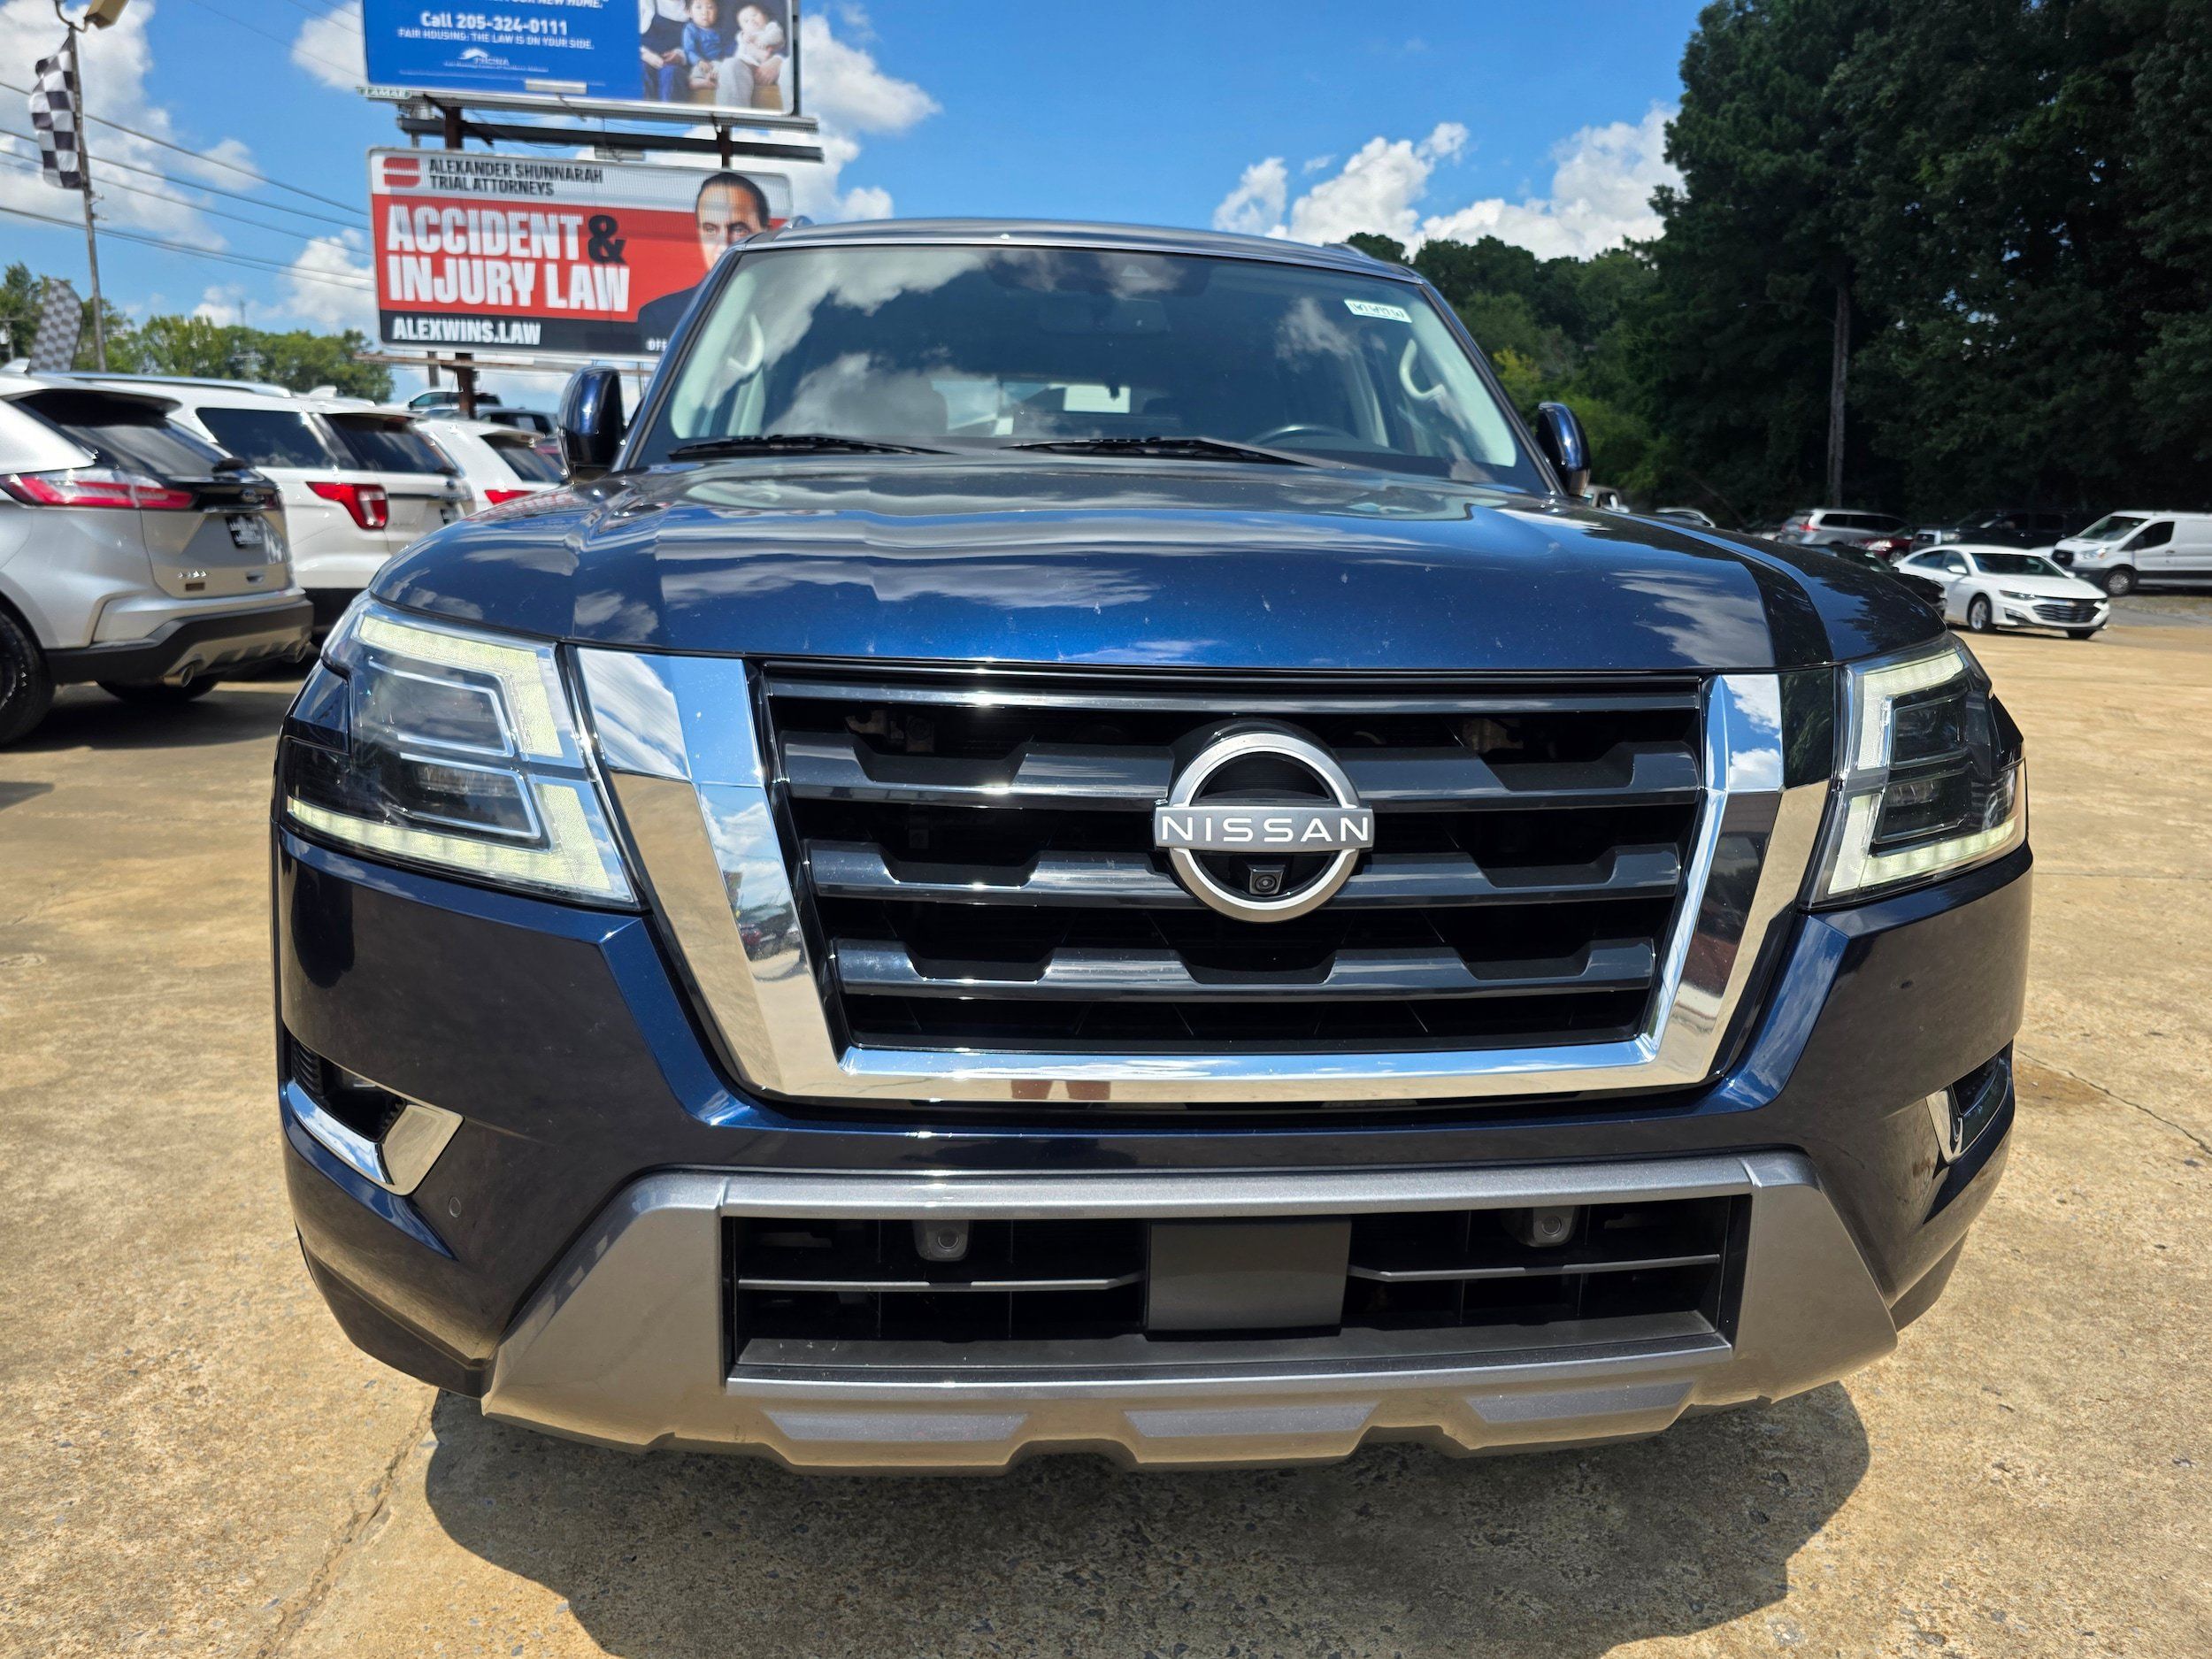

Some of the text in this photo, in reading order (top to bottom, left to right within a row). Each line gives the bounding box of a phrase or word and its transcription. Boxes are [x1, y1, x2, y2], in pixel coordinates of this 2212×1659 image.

[420, 11, 568, 35] Call 205-324-0111
[396, 27, 421, 39] FAIR
[471, 32, 489, 42] THE
[492, 33, 514, 44] LAW
[515, 35, 526, 45] IS
[526, 35, 541, 46] ON
[541, 36, 567, 48] YOUR
[568, 38, 595, 50] SIDE.
[428, 158, 603, 184] ALEXANDER SHUNNARAH
[429, 175, 554, 196] TRIAL ATTORNEYS
[387, 204, 627, 265] ACCIDENT &
[387, 254, 630, 312] INJURY LAW
[392, 316, 541, 346] ALEXWINS.LAW
[1162, 816, 1369, 841] NISSAN
